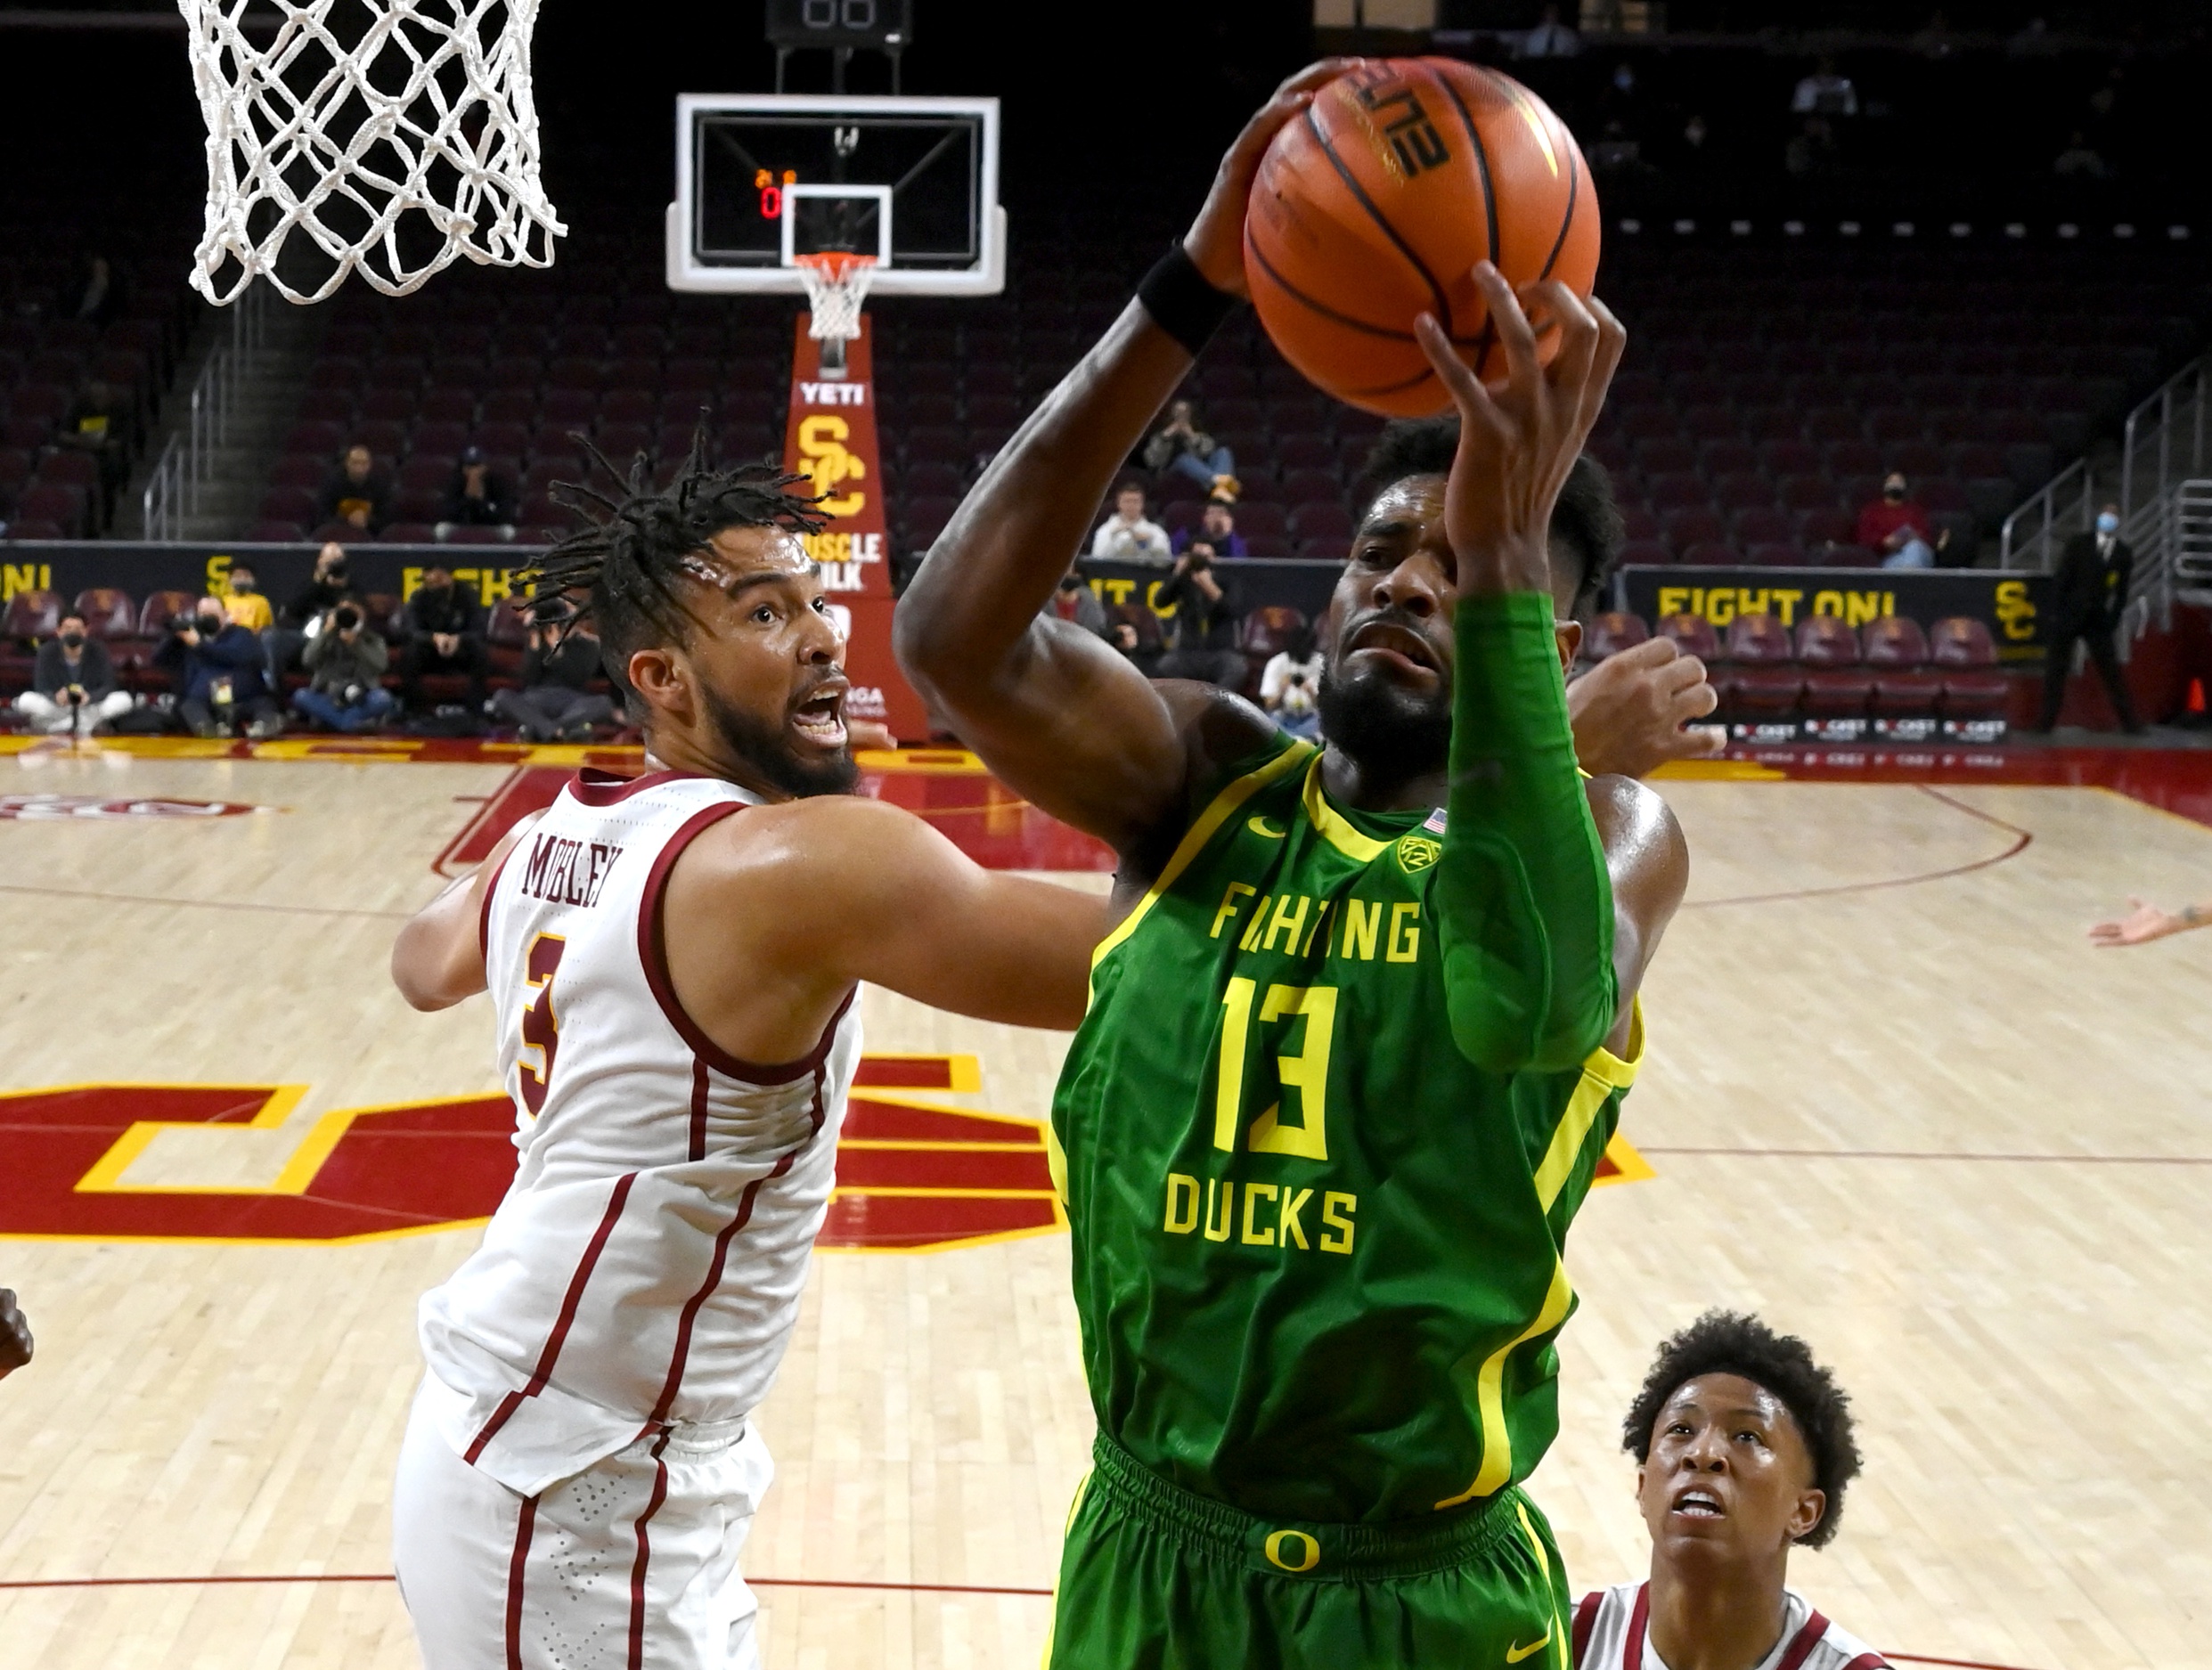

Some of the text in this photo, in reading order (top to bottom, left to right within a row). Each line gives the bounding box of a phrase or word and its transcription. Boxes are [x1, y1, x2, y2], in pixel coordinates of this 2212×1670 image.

[799, 382, 865, 405] YETI
[820, 562, 865, 591] ILK
[1659, 586, 1804, 628] FIGHT
[522, 832, 624, 908] MOBLEY
[518, 931, 567, 1122] 3
[1212, 976, 1339, 1161] 13
[1163, 1172, 1359, 1256] DUCKS
[1264, 1528, 1321, 1572] O
